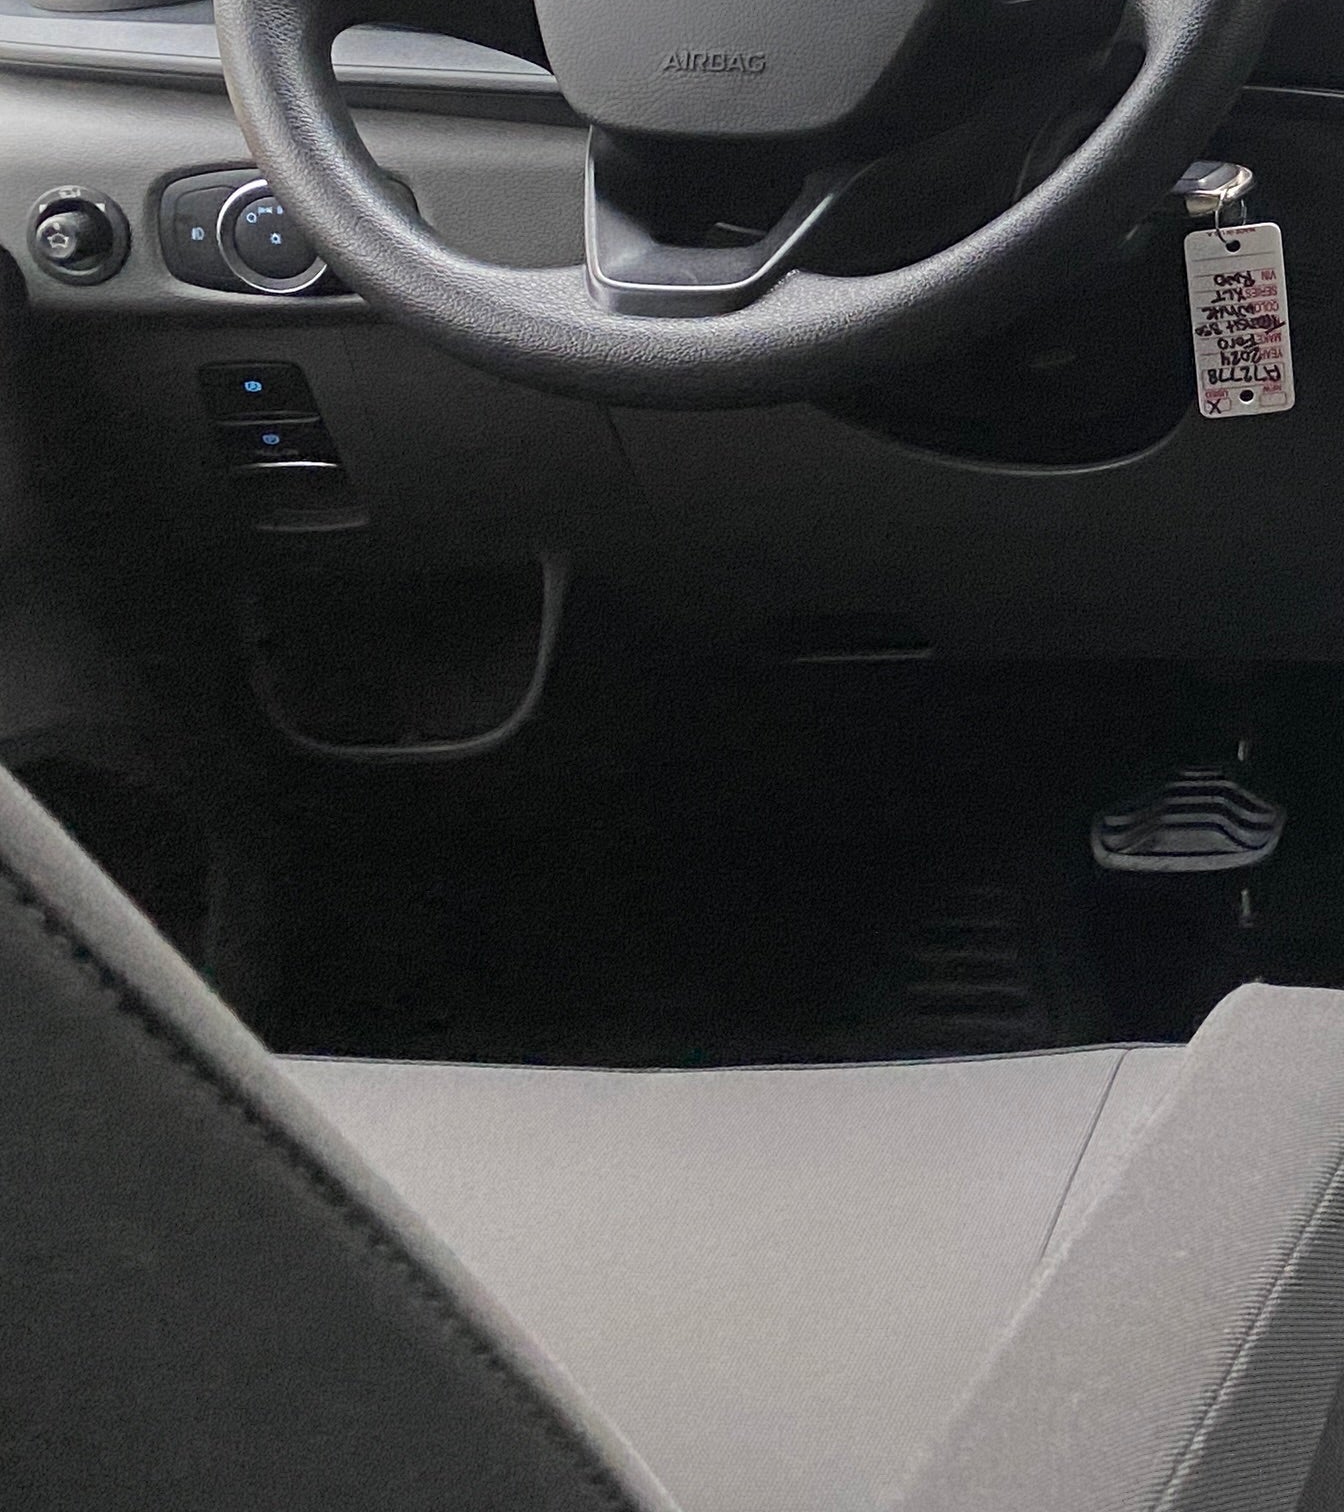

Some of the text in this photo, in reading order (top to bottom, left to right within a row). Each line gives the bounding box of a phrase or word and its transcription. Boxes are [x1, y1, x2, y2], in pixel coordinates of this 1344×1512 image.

[662, 50, 767, 75] AIRBAG
[1261, 270, 1277, 281] VIN
[1211, 287, 1247, 304] XLT
[1220, 346, 1262, 366] 2024
[1208, 364, 1281, 384] A72778
